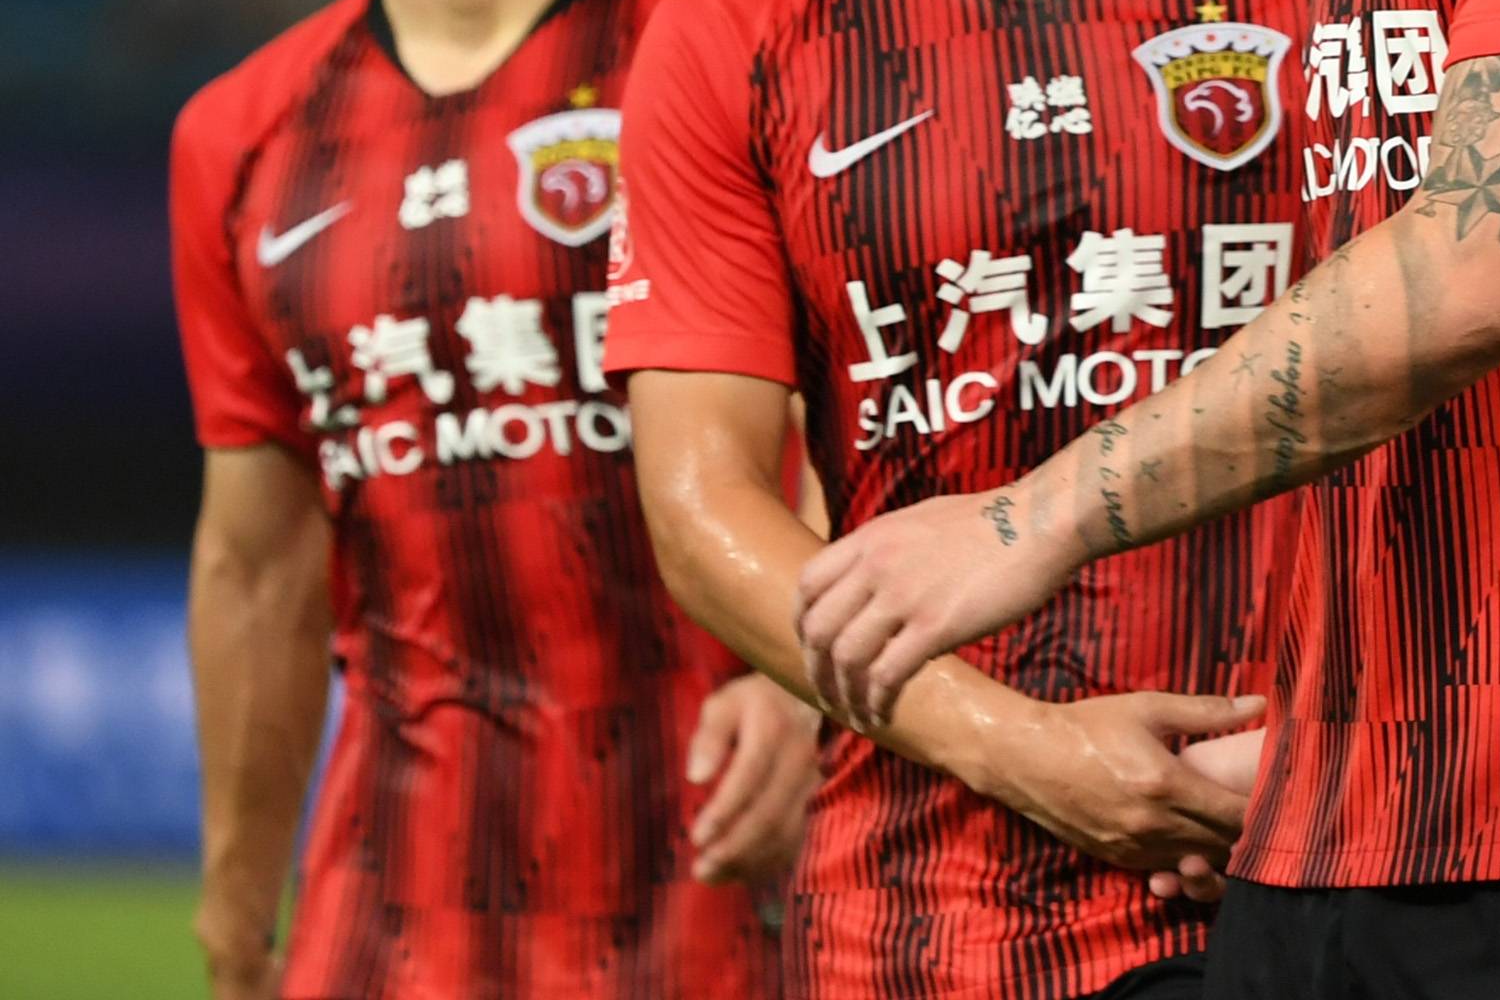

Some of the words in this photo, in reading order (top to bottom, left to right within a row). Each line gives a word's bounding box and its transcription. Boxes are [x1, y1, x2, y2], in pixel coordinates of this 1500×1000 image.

[847, 222, 1293, 383] 上汽集团
[435, 402, 632, 465] MOTO
[854, 371, 998, 451] SAIC
